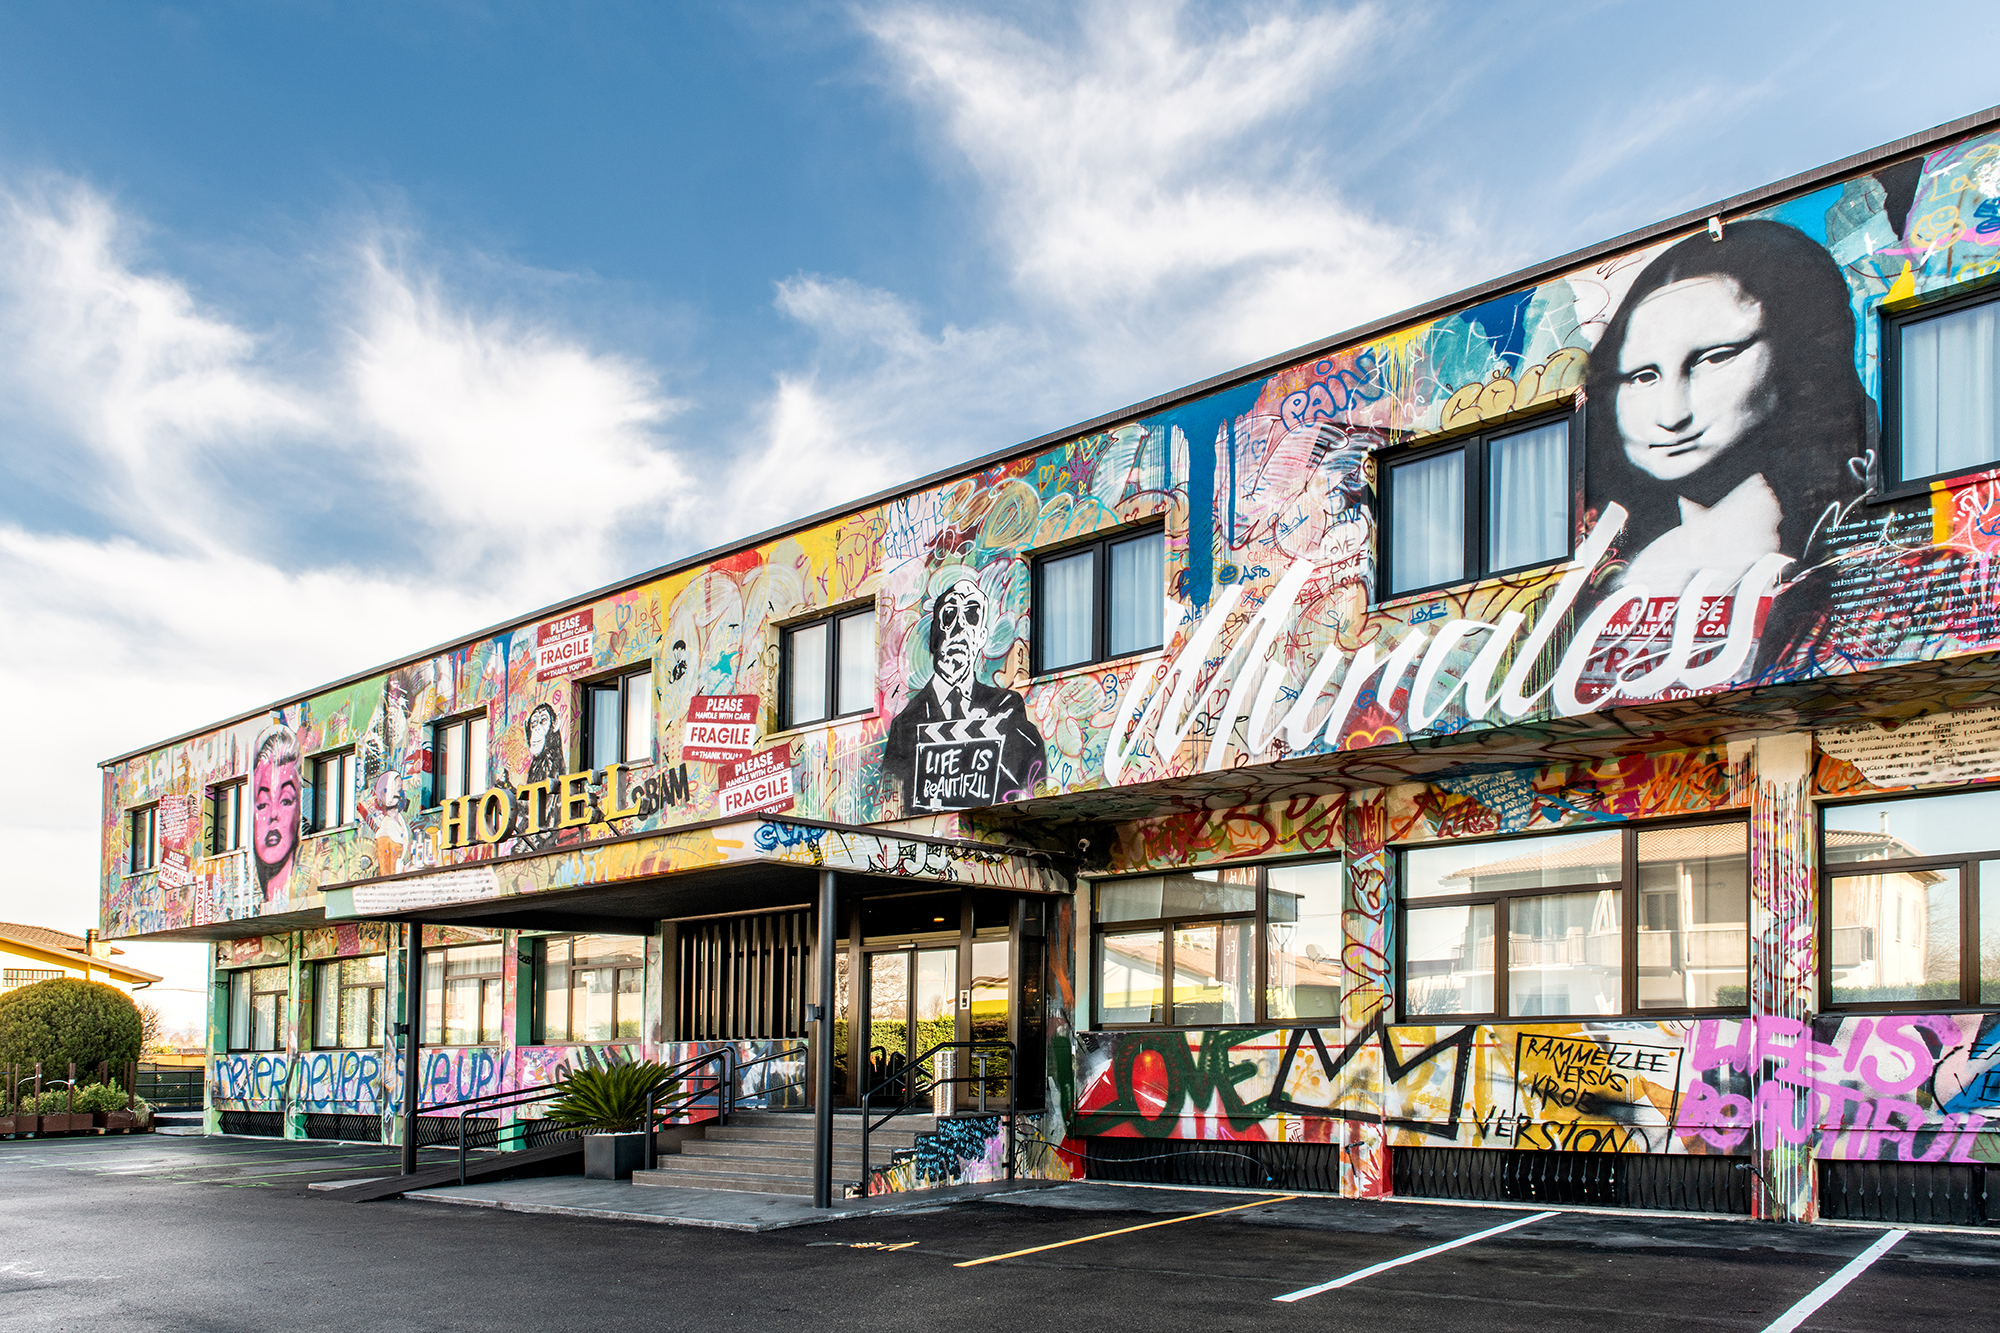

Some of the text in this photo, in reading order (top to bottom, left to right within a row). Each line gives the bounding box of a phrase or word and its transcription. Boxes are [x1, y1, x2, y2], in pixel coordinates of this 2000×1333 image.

[1628, 602, 1725, 622] PLESE
[542, 632, 561, 645] HANDLE
[574, 625, 588, 636] CARE
[551, 616, 580, 635] PLEASE
[541, 638, 589, 666] FRAGILE
[695, 712, 718, 720] HANDLE
[734, 713, 751, 721] CARE
[706, 698, 743, 712] PLEASE
[690, 727, 750, 745] FRAGILE
[735, 752, 773, 776] PLEASE
[925, 748, 993, 775] LIFE IS
[725, 762, 784, 788] HANDLE WITH CARE
[439, 762, 648, 850] HOTEL
[726, 776, 789, 811] FRAGILE
[161, 866, 188, 885] FRAGILE
[1843, 1015, 1963, 1095] IS
[1052, 1029, 1290, 1139] LOVE
[1553, 1056, 1629, 1092] VERSUS
